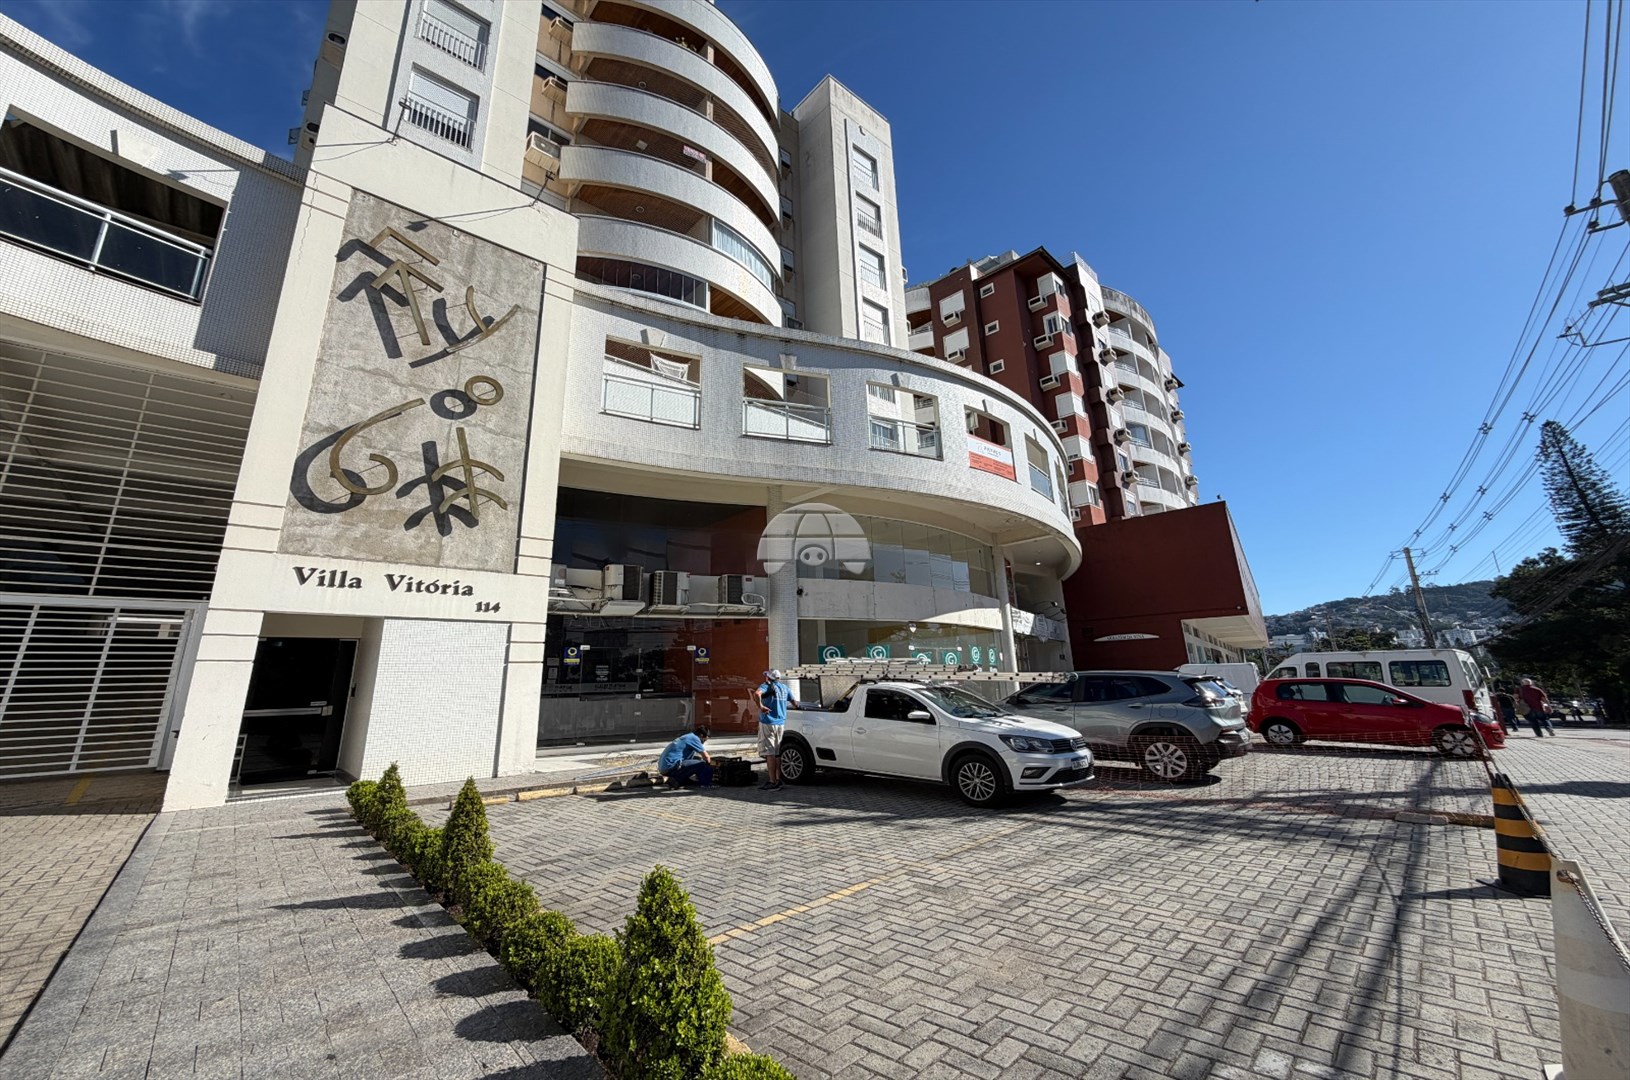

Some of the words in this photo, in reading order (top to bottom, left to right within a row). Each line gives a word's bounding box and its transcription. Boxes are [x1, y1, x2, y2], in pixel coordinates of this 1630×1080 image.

[292, 566, 363, 589] Villa
[384, 573, 474, 597] Vitória
[474, 601, 501, 614] 114
